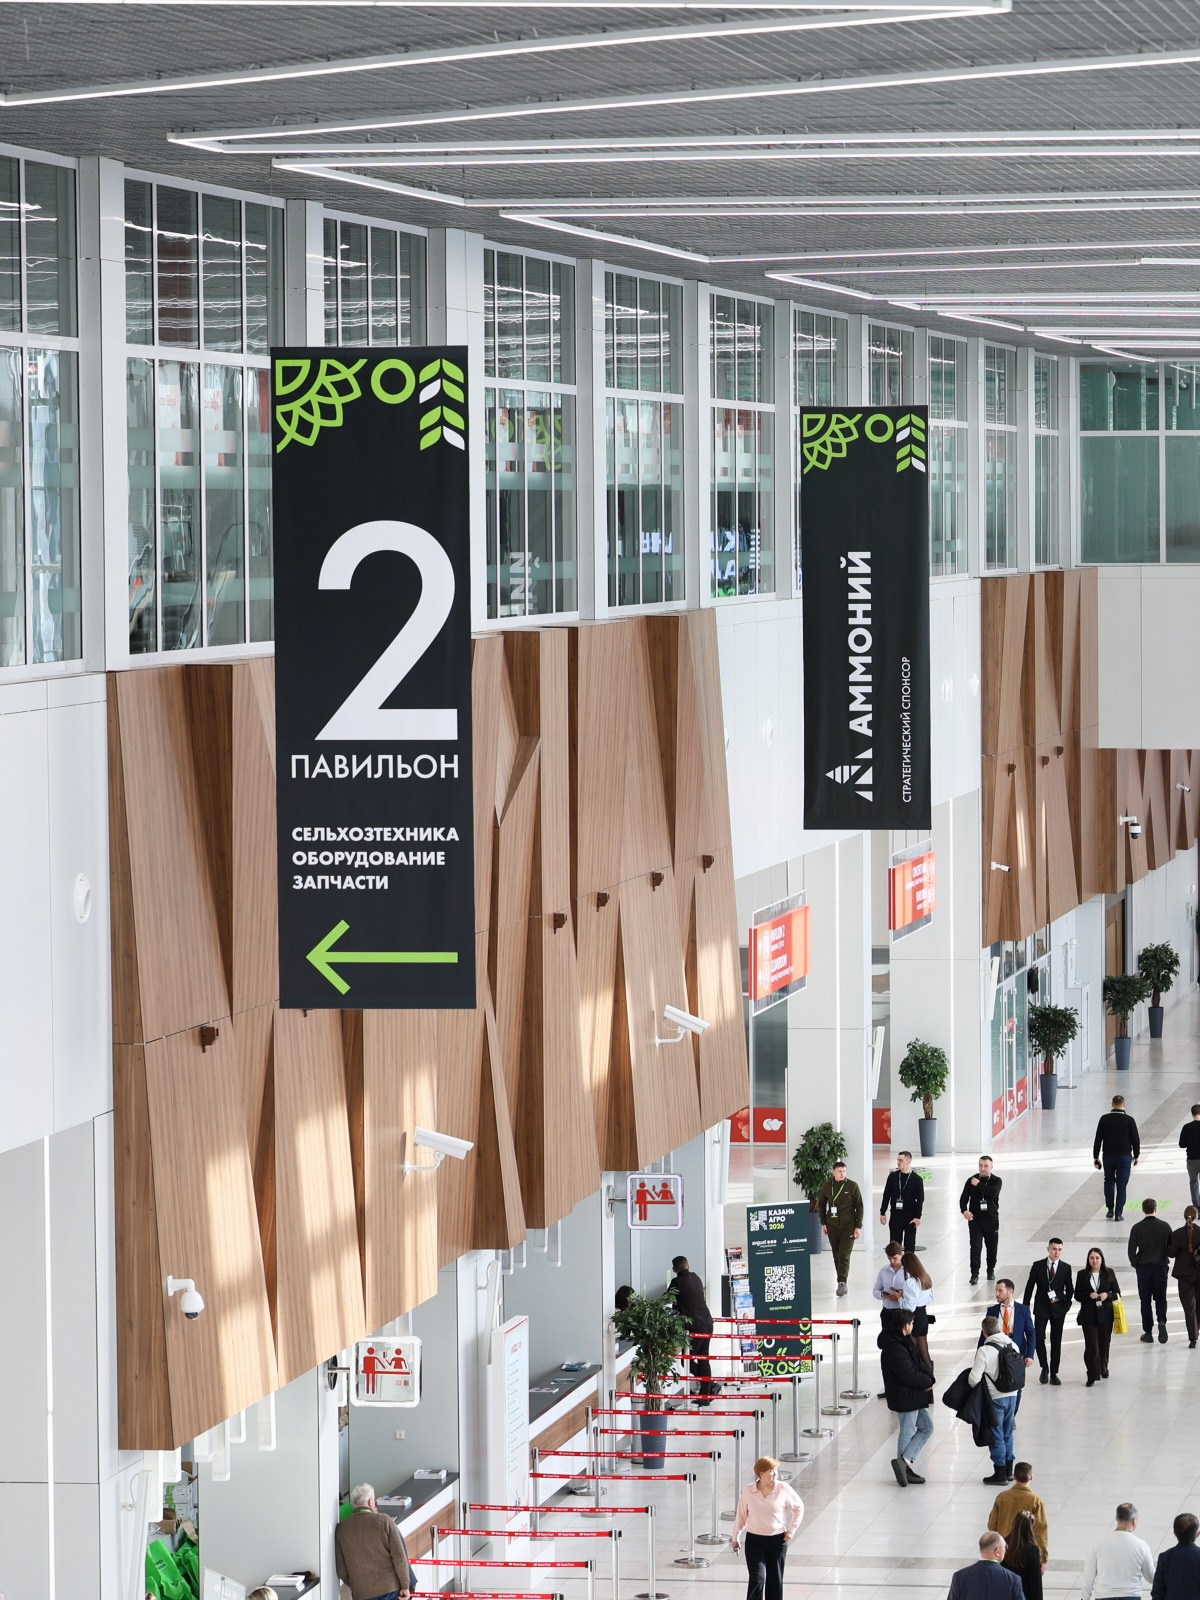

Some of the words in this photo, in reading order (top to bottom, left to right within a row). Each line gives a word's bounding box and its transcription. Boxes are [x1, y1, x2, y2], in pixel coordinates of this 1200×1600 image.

[314, 520, 458, 741] 2
[839, 551, 873, 738] АММОНИЙ
[901, 656, 911, 710] СПОНСОР
[291, 754, 459, 779] ПАВИЛЬОН
[899, 712, 912, 803] СТРАТЕГИЧЕСКИЙ
[292, 827, 460, 842] СЕЛЬХОЗТЕХНИКА
[292, 851, 446, 867] ОБОРУДОВАНИЕ
[292, 875, 389, 890] ЗАПЧАСТИ
[768, 1208, 795, 1216] КАЗАНЬ
